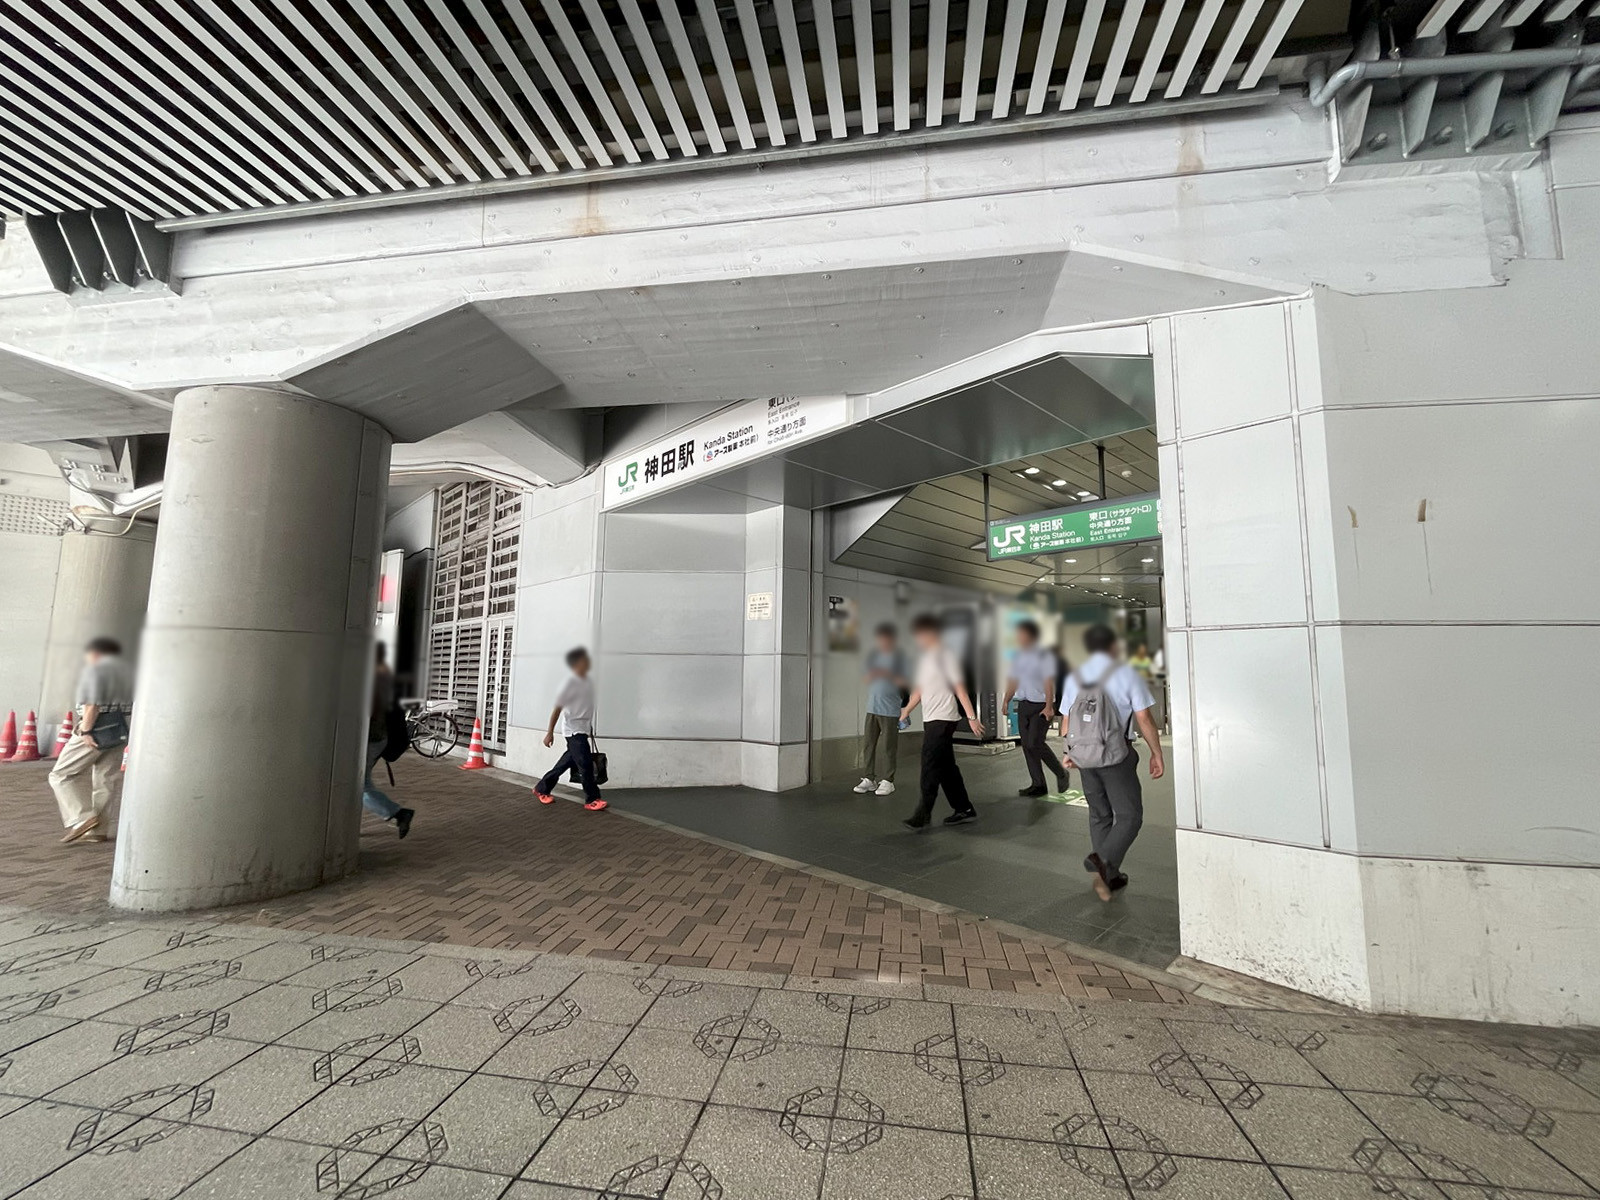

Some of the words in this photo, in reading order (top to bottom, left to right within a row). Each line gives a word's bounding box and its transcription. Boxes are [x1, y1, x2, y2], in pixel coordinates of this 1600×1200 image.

[704, 435, 726, 451] Kanda
[727, 425, 753, 441] Station
[644, 439, 695, 484] 神田駅
[618, 461, 639, 487] JR
[993, 524, 1026, 548] JR
[1029, 518, 1063, 534] 神田駅
[1029, 534, 1051, 542] Kanda
[1052, 530, 1076, 539] Station
[1104, 526, 1131, 534] Entrance
